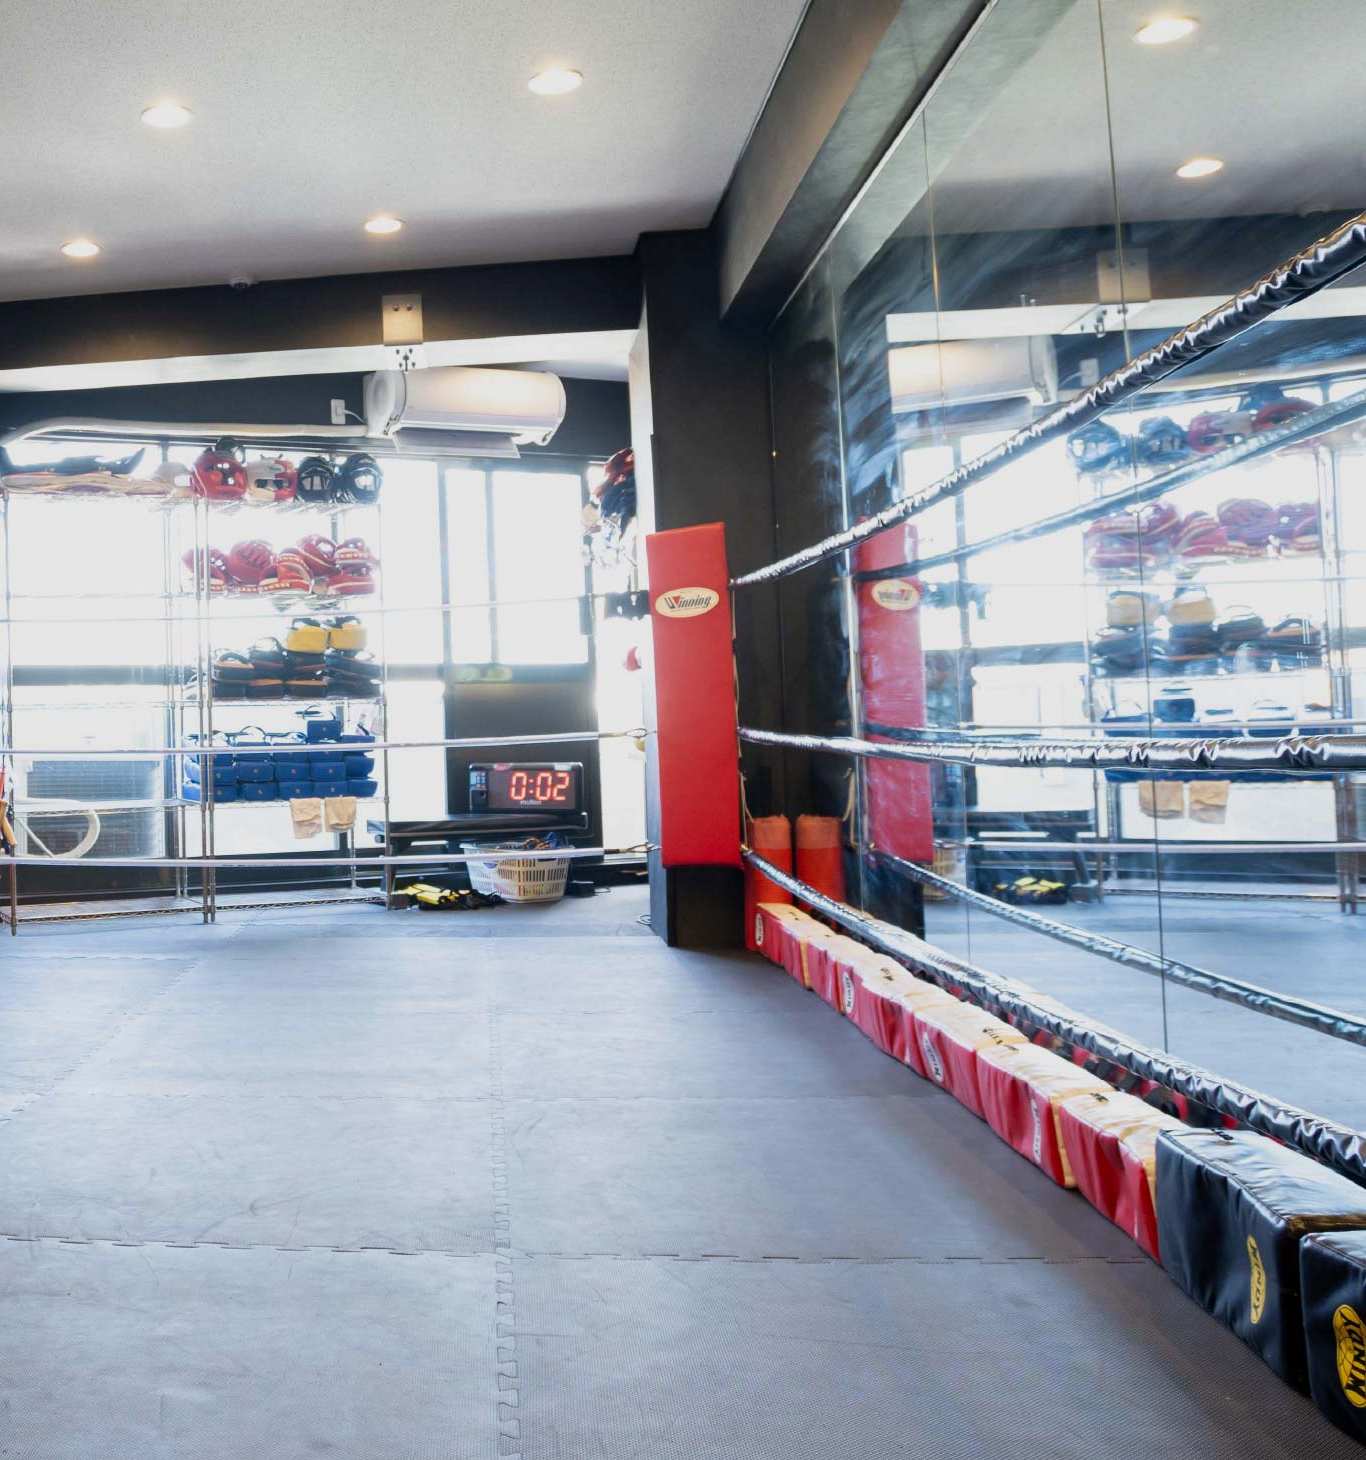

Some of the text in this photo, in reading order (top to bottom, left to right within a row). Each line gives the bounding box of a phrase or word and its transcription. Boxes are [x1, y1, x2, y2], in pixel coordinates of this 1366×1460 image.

[664, 594, 712, 609] Winning
[509, 770, 570, 801] 0:02
[1250, 1242, 1263, 1318] WINDY
[1339, 1310, 1366, 1400] WINDY
